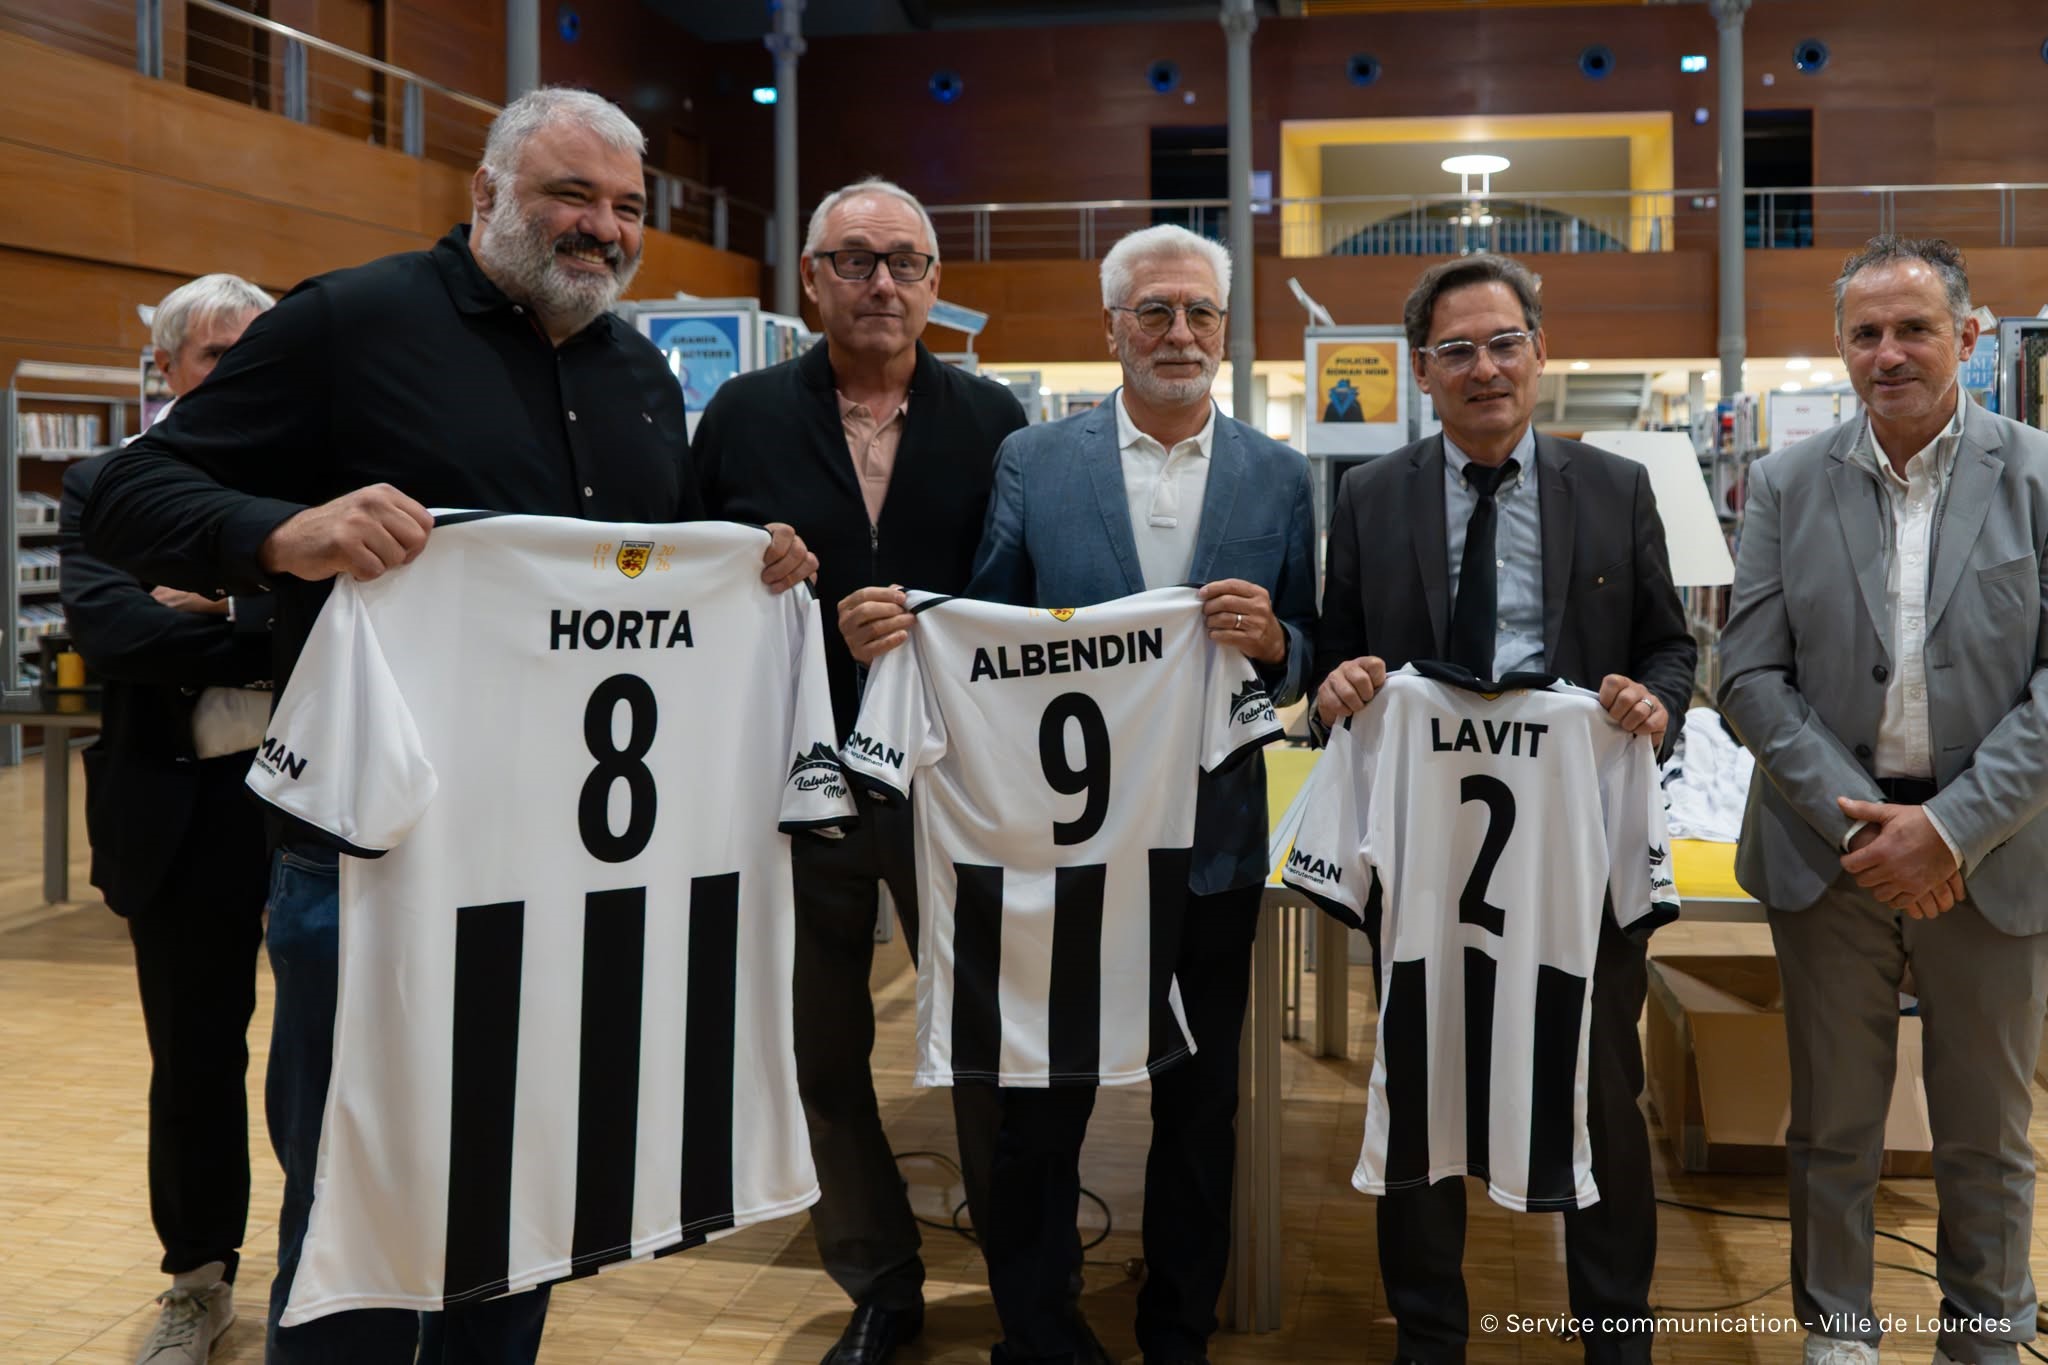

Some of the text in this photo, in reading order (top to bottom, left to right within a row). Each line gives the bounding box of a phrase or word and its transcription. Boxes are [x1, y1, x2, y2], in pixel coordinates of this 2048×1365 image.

[671, 335, 718, 345] GRANDS
[1336, 357, 1379, 365] POLICIER
[1326, 368, 1362, 376] ROMAN
[550, 609, 694, 651] HORTA
[969, 627, 1163, 683] ALBENDIN
[1431, 717, 1549, 758] LAVIT
[578, 674, 658, 864] 8
[1039, 692, 1112, 847] 9
[1459, 774, 1517, 938] 2
